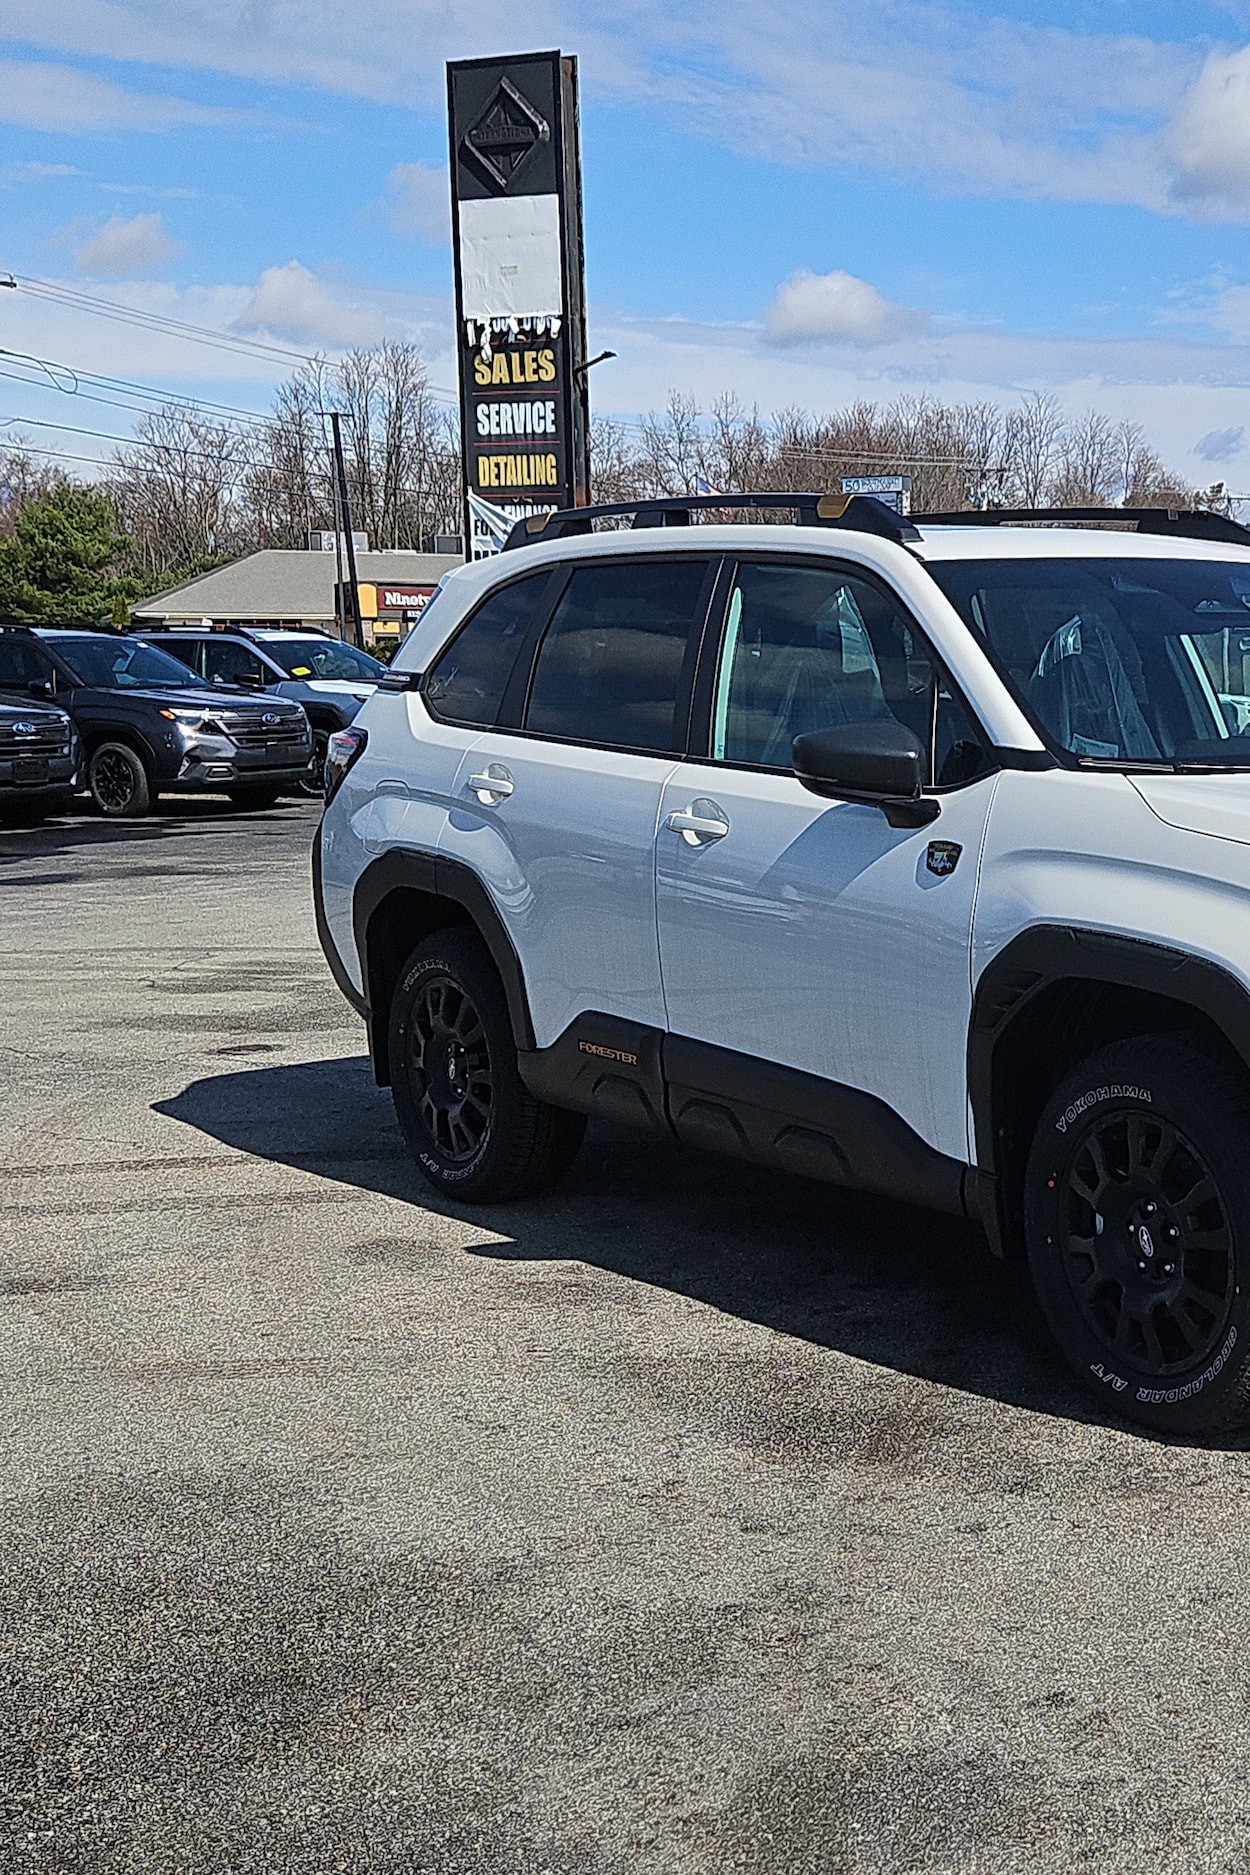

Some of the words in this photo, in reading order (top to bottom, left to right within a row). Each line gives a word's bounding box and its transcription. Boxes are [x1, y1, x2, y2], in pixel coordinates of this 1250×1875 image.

[474, 349, 556, 385] SALES
[476, 401, 556, 436] SERVICE
[478, 454, 558, 487] DETAILING
[578, 1040, 638, 1066] FORESTER
[1056, 1084, 1152, 1133] YOKOHAMA
[1090, 1363, 1129, 1392] A/T
[1136, 1326, 1238, 1404] GEOLANDAR
